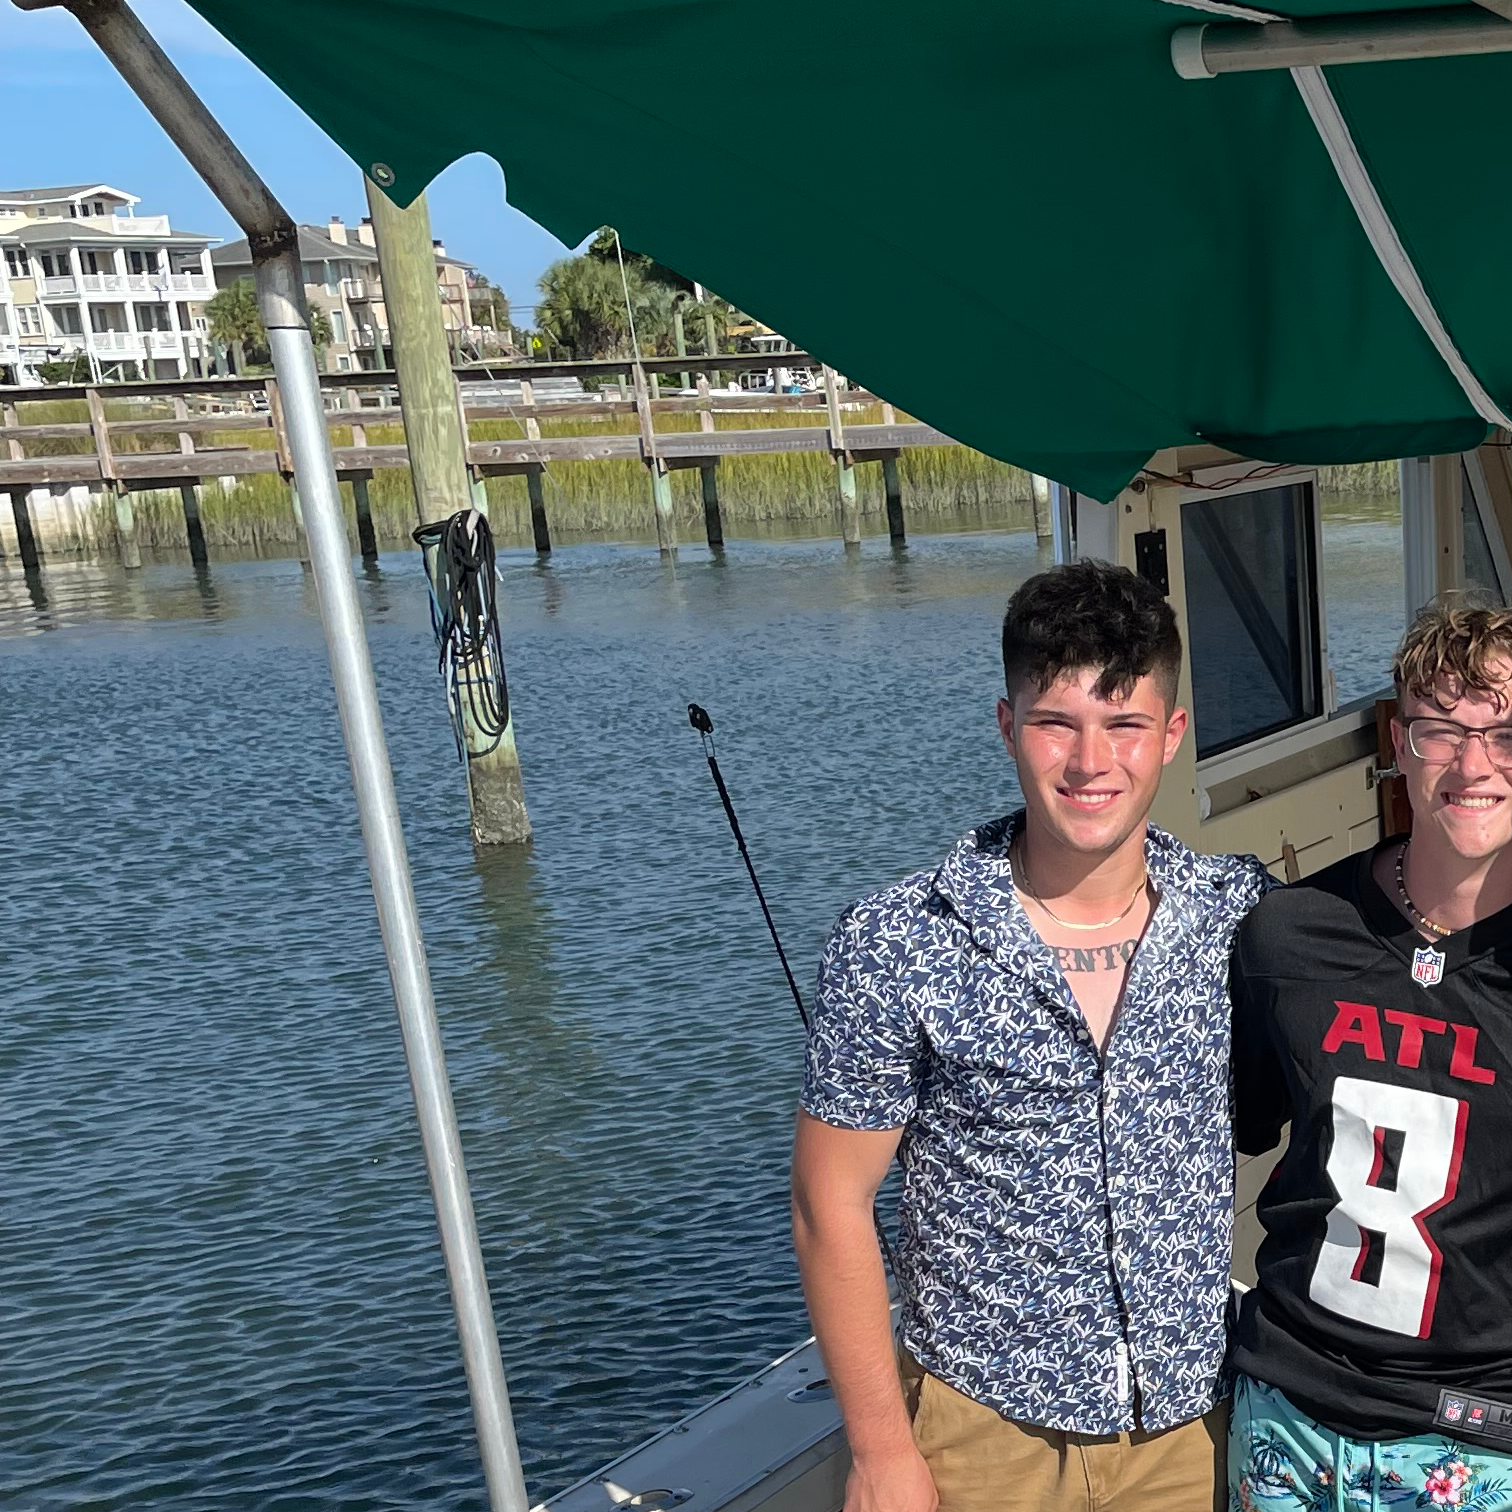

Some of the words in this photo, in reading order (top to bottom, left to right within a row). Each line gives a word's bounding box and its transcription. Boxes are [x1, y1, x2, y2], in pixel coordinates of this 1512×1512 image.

[1415, 963, 1438, 981] NFL
[1321, 1000, 1496, 1086] ATL
[1309, 1076, 1470, 1340] 8
